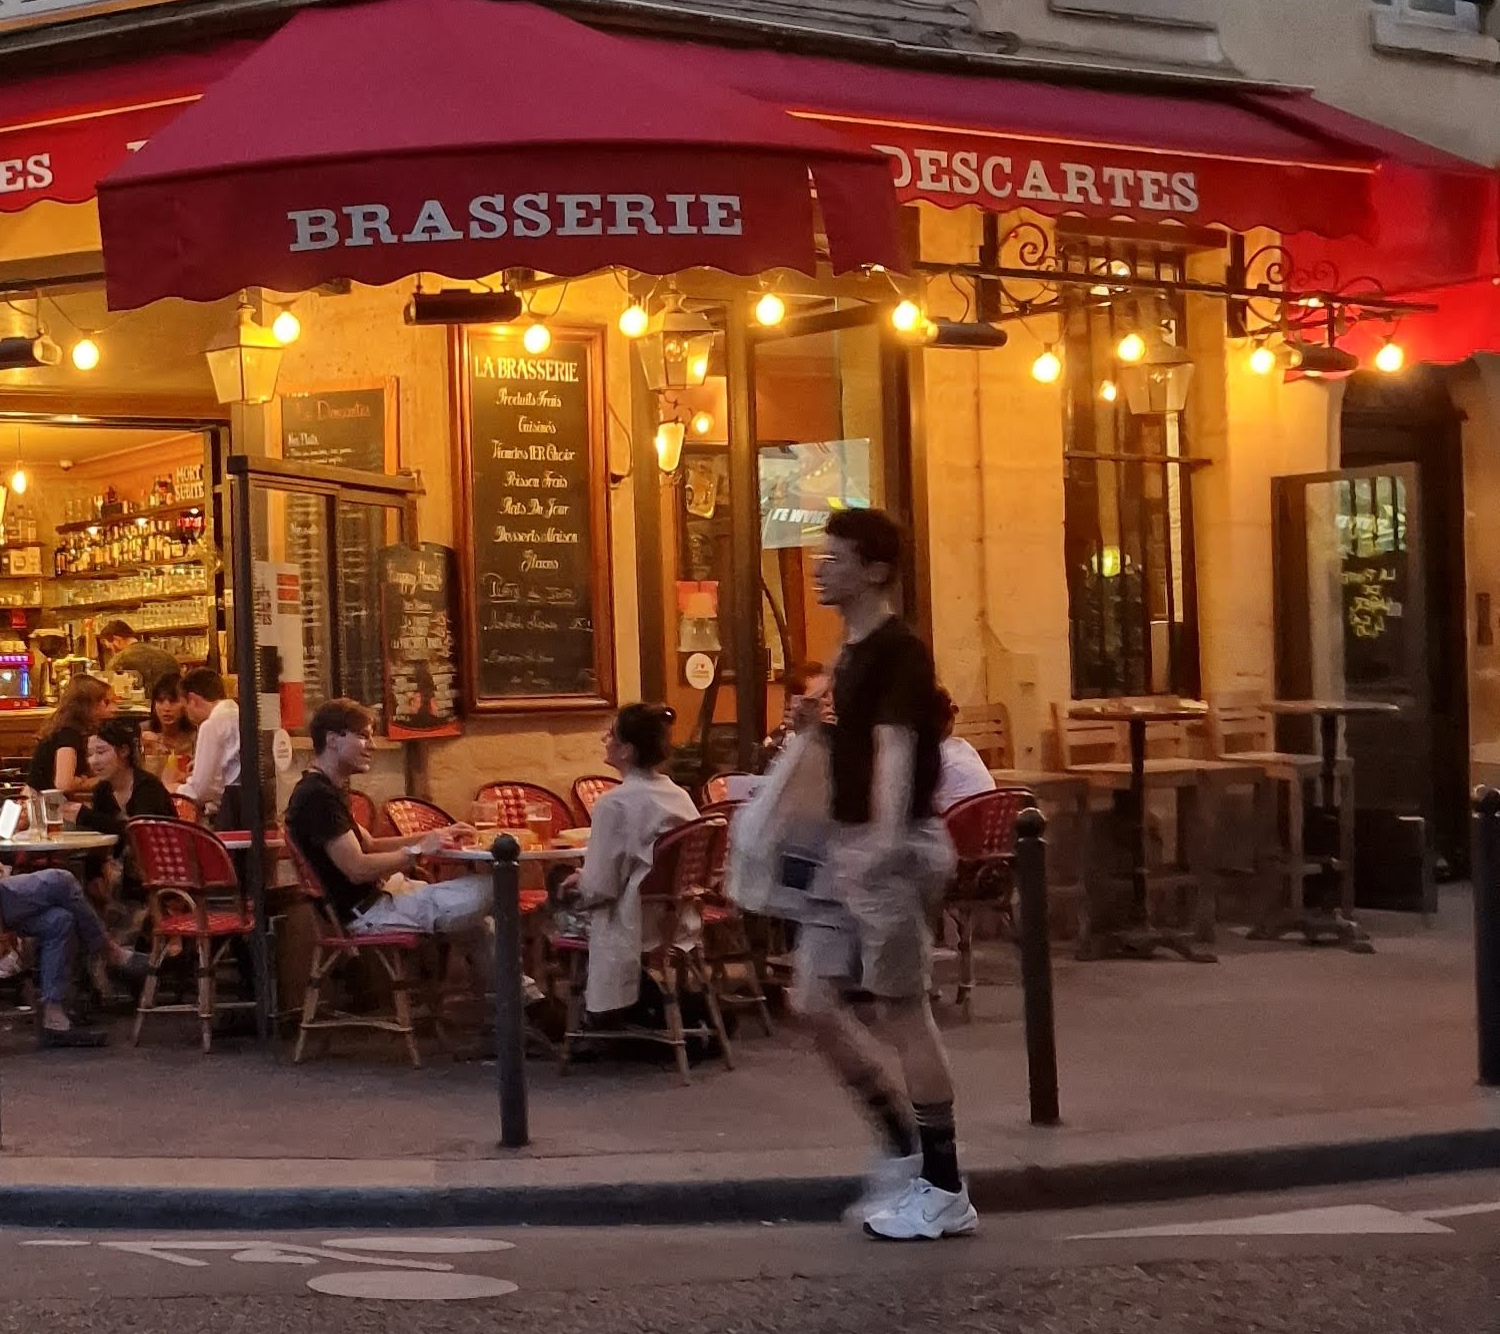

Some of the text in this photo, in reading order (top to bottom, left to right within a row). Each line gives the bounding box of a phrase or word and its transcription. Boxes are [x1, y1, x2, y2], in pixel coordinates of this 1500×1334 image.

[286, 192, 744, 252] BRASSERIE
[474, 354, 579, 383] LA BRASSERIE
[495, 386, 563, 408] Produits Frais
[541, 470, 568, 488] Frais
[545, 497, 570, 518] Jour
